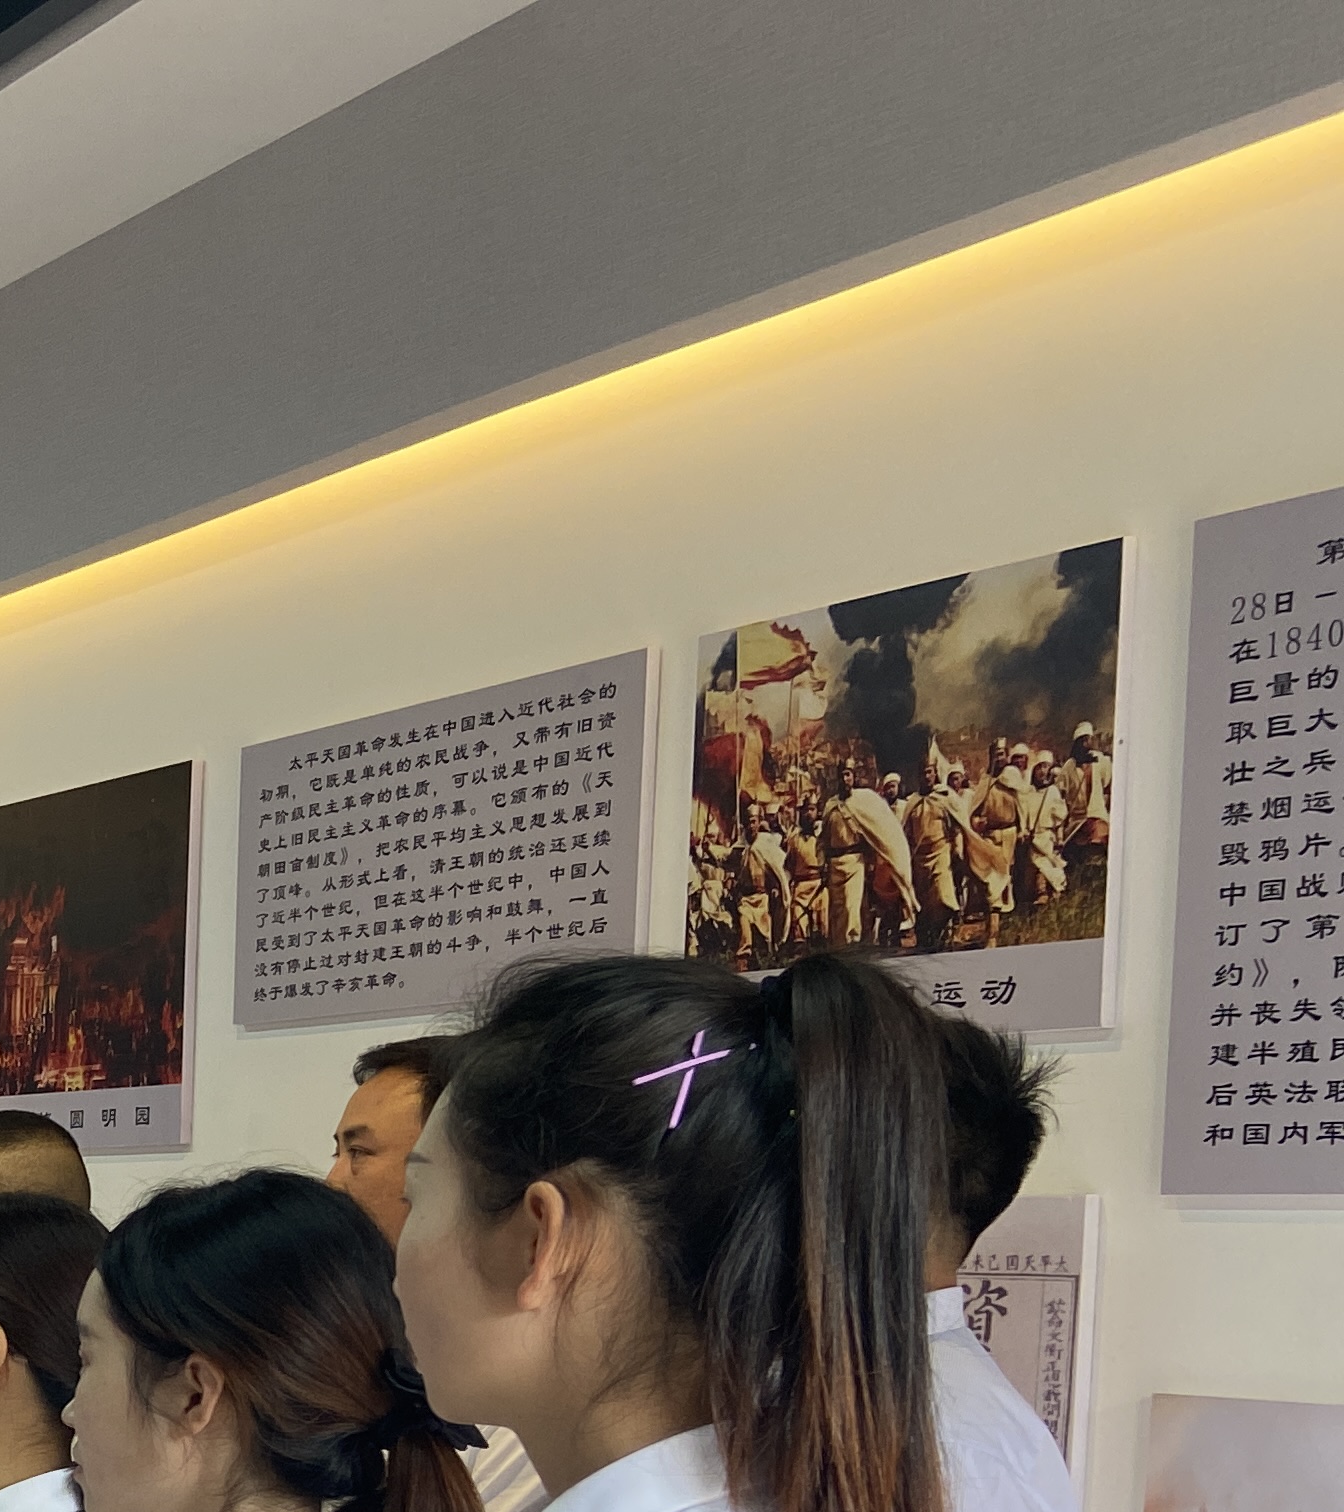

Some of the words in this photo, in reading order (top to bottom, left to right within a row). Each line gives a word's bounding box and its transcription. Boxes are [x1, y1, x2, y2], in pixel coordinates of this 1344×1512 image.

[1316, 538, 1344, 565] 第
[1229, 664, 1339, 704] 巨量的
[1225, 707, 1339, 744] 取巨大
[1222, 749, 1336, 786] 壮之兵
[1214, 914, 1341, 947] 订了第
[254, 972, 404, 1002] 终于爆发了辛亥革命。
[930, 973, 1018, 1008] 运动
[39, 1106, 151, 1129] 圆明园
